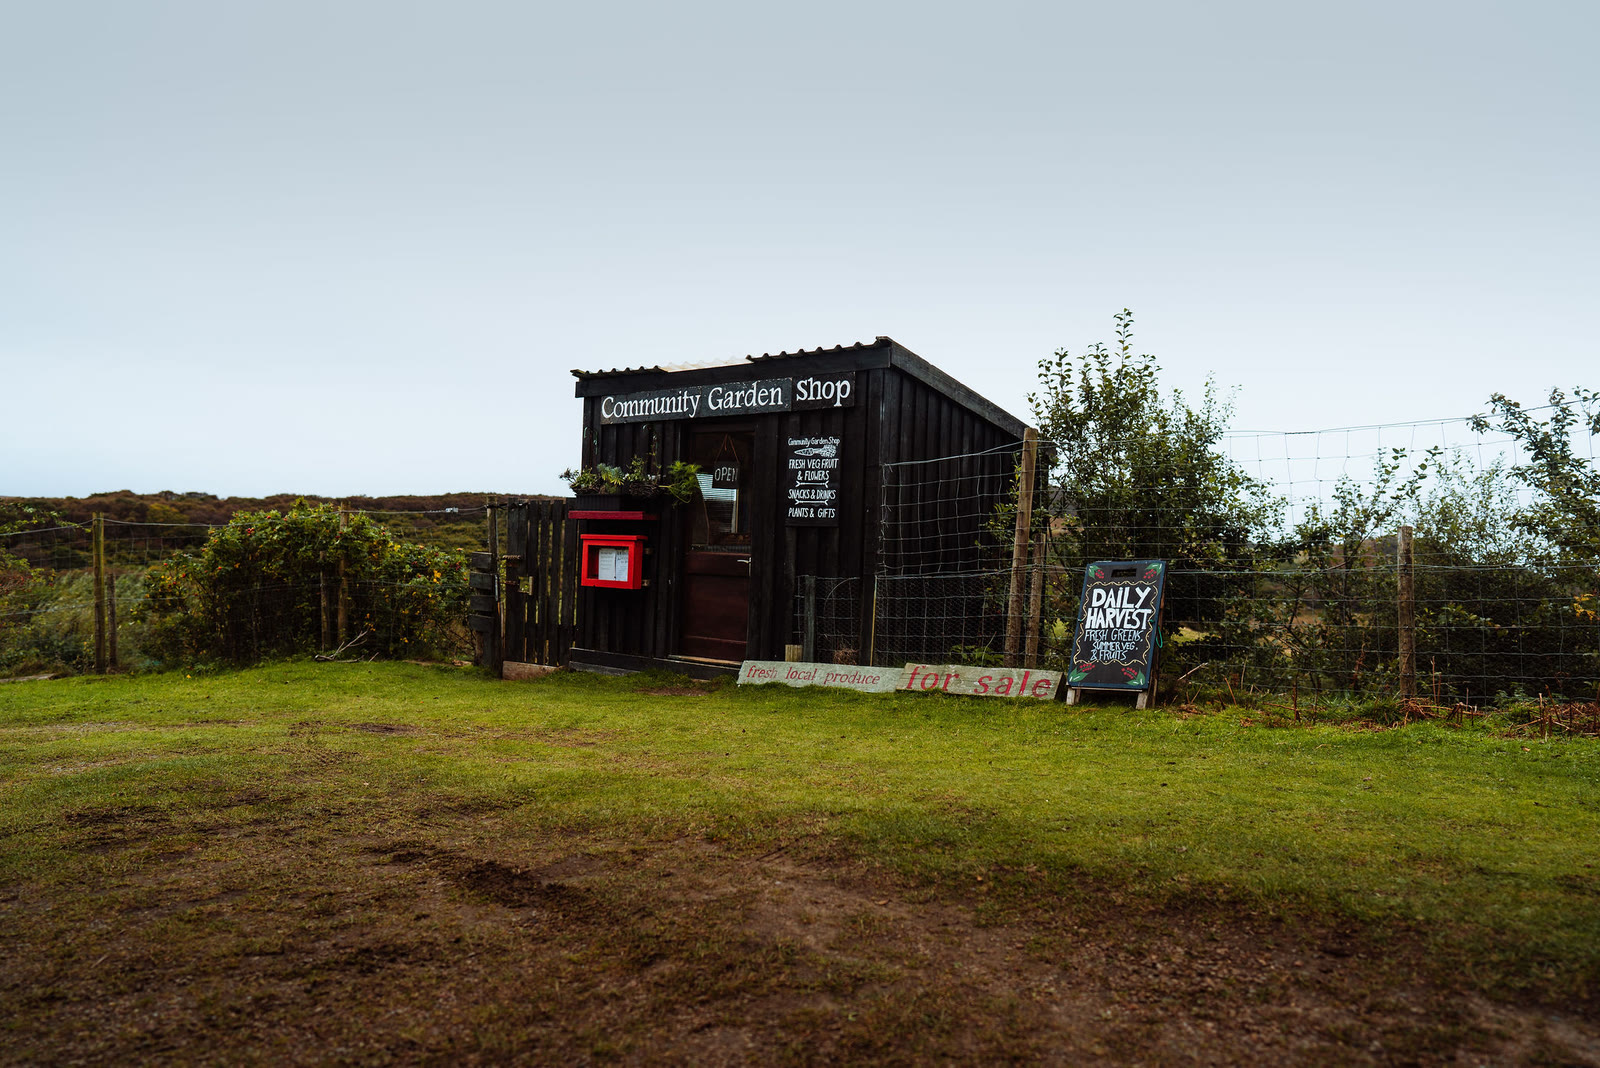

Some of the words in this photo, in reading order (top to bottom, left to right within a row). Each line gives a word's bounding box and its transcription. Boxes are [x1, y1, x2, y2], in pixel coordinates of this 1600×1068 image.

[601, 390, 701, 418] Community
[708, 381, 783, 410] Garden
[788, 437, 810, 447] Community
[788, 458, 805, 469] FRESH
[807, 458, 820, 469] VEG
[821, 458, 839, 469] FRUIT
[714, 466, 738, 482] OPEN
[797, 470, 803, 480] &
[804, 470, 829, 481] FLOWERS
[788, 489, 810, 499] SNACKS
[810, 489, 815, 499] &
[816, 489, 836, 499] DRINKS
[788, 507, 809, 518] PLANTS
[810, 508, 814, 518] &
[818, 508, 836, 518] GIFTS
[1085, 607, 1152, 630] HARVEST
[1084, 629, 1108, 641] FRESH
[1092, 639, 1120, 651] SUMMER
[1090, 649, 1098, 660] &
[746, 665, 778, 679] fresh
[785, 666, 818, 681] local
[824, 671, 880, 685] produce
[906, 665, 960, 692] for
[974, 670, 1051, 698] sale
